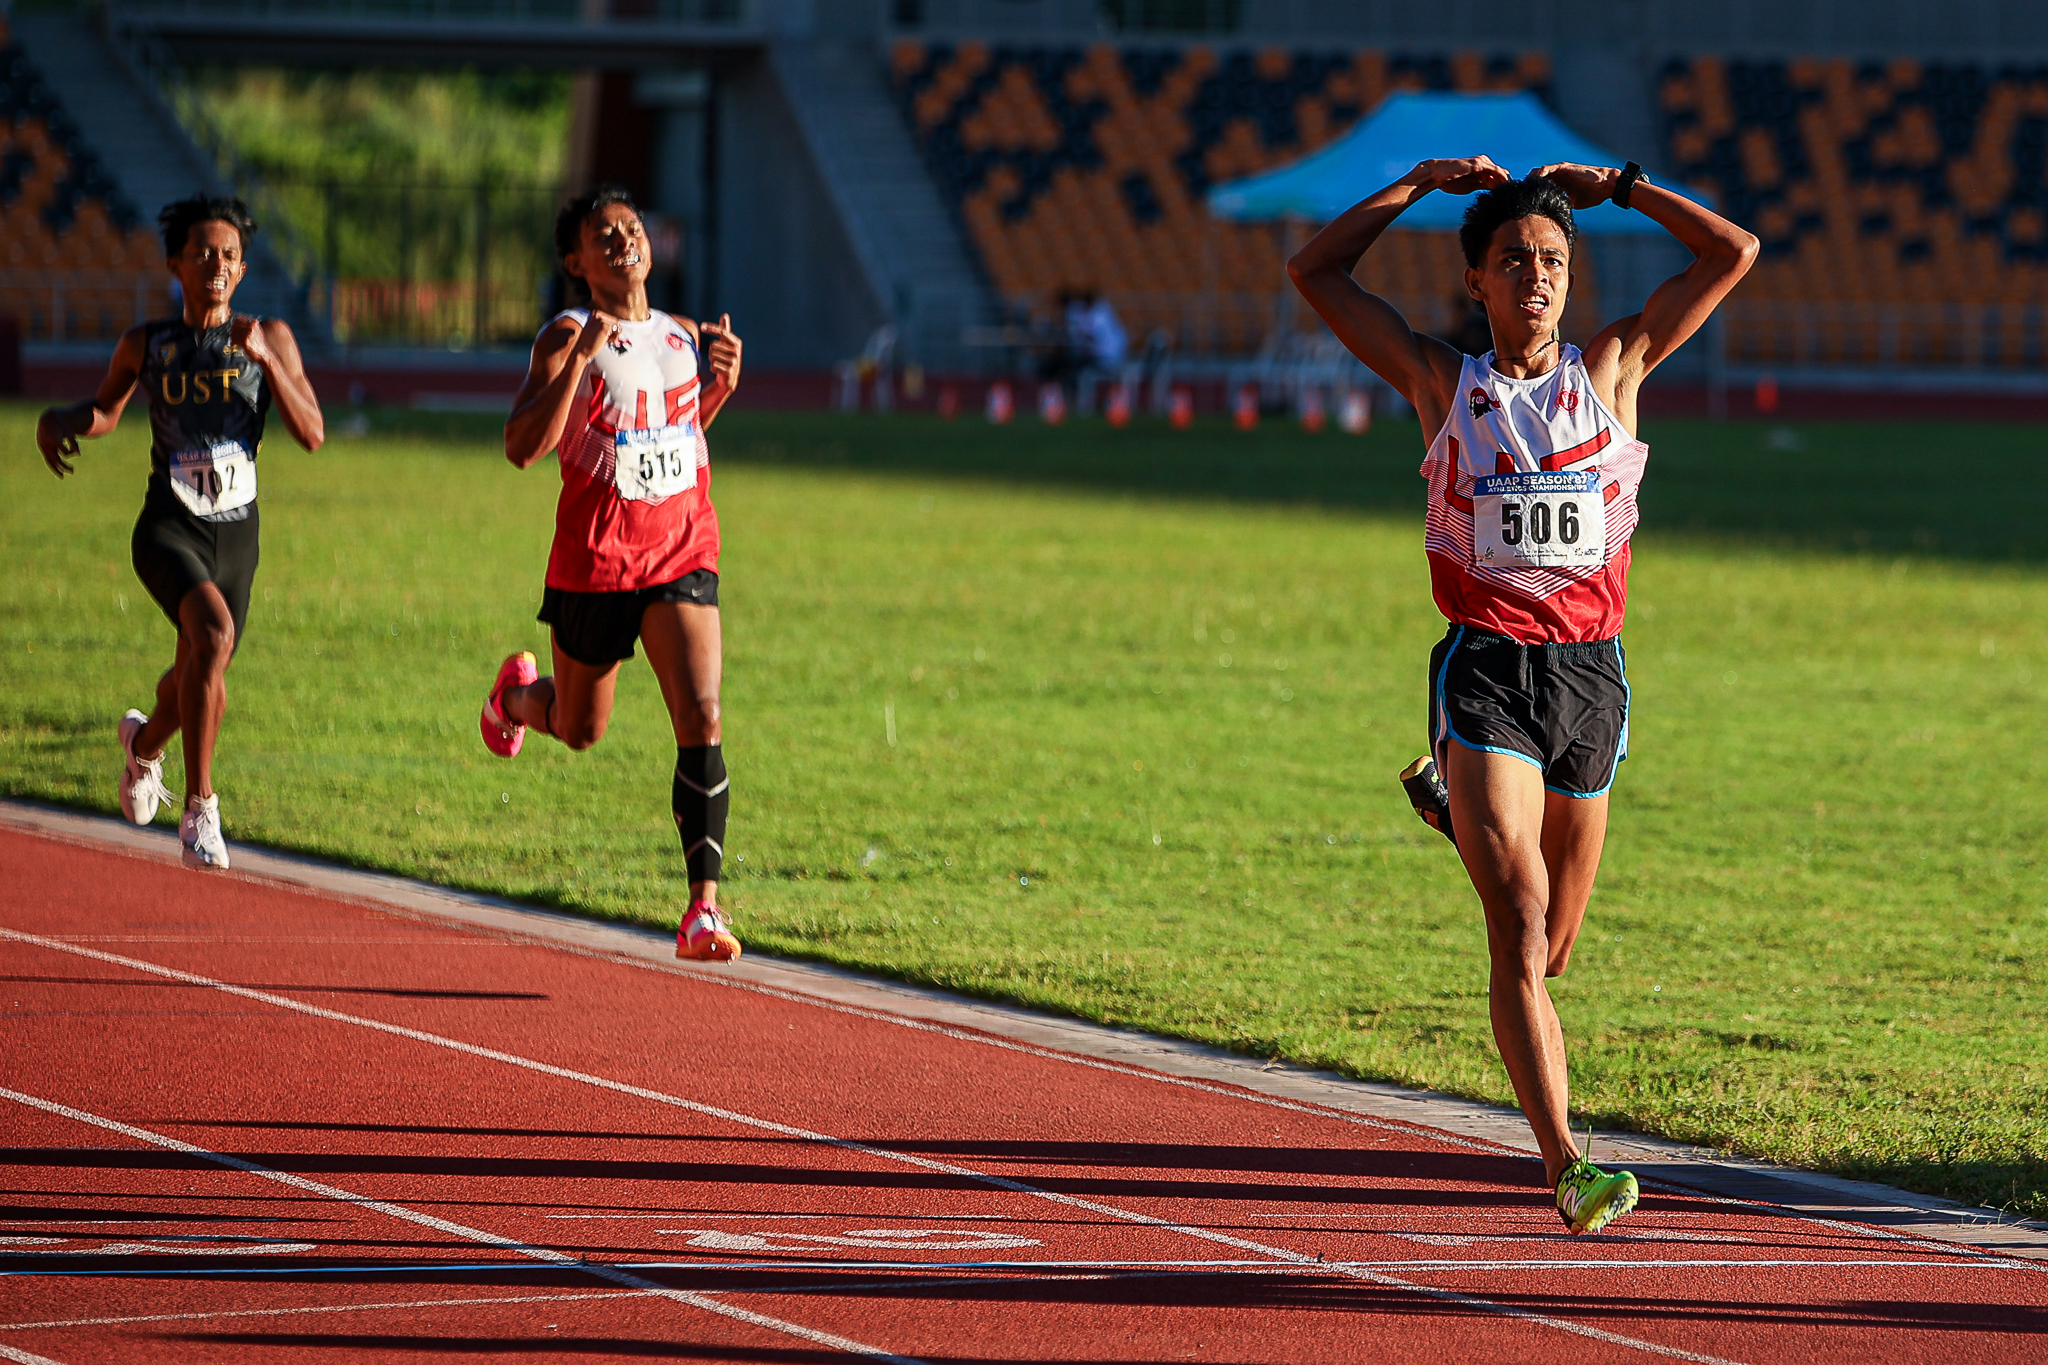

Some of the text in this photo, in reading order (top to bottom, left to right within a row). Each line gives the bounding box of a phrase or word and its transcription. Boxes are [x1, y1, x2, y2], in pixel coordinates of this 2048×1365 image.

[162, 368, 240, 405] UST
[640, 449, 681, 480] 515
[191, 464, 237, 498] 702
[1487, 476, 1520, 488] UAAP
[1523, 474, 1571, 486] SEASON
[1529, 484, 1588, 492] CHAMPIONSHIPS
[1501, 501, 1580, 546] 506
